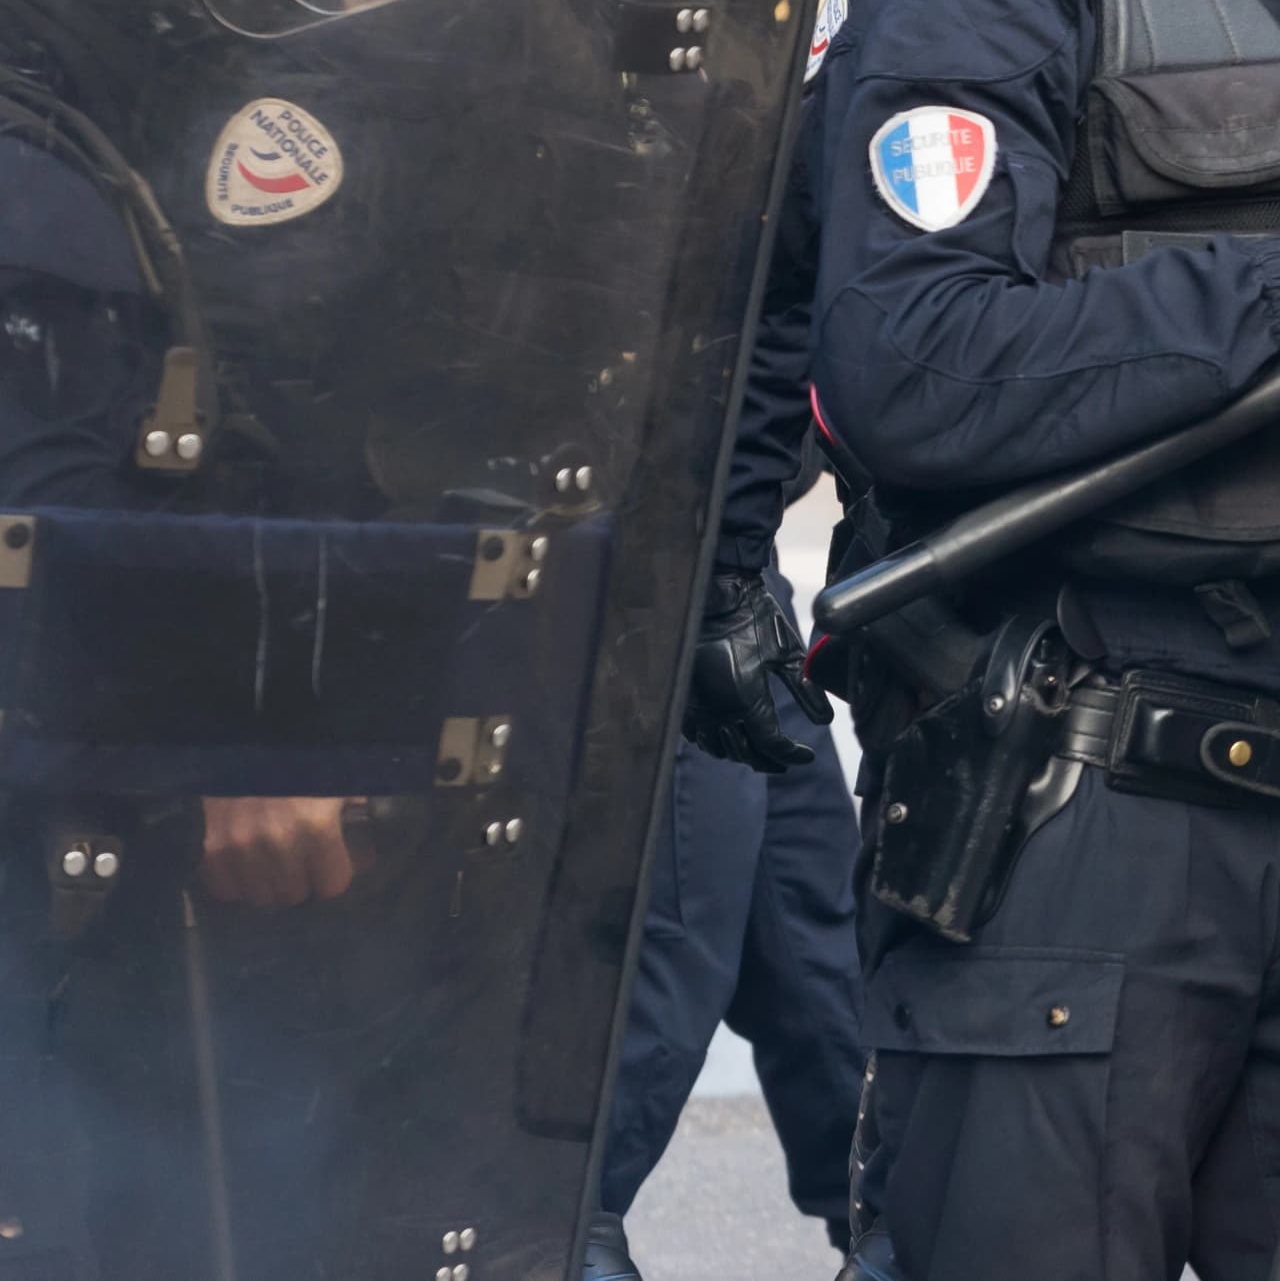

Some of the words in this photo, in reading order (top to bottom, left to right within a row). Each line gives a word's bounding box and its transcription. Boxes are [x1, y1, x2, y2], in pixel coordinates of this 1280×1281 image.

[250, 109, 329, 185] NATIONALE
[278, 109, 328, 159] POLICE
[893, 156, 977, 185] PUBLIQUE
[231, 198, 295, 216] PUBLIQUE
